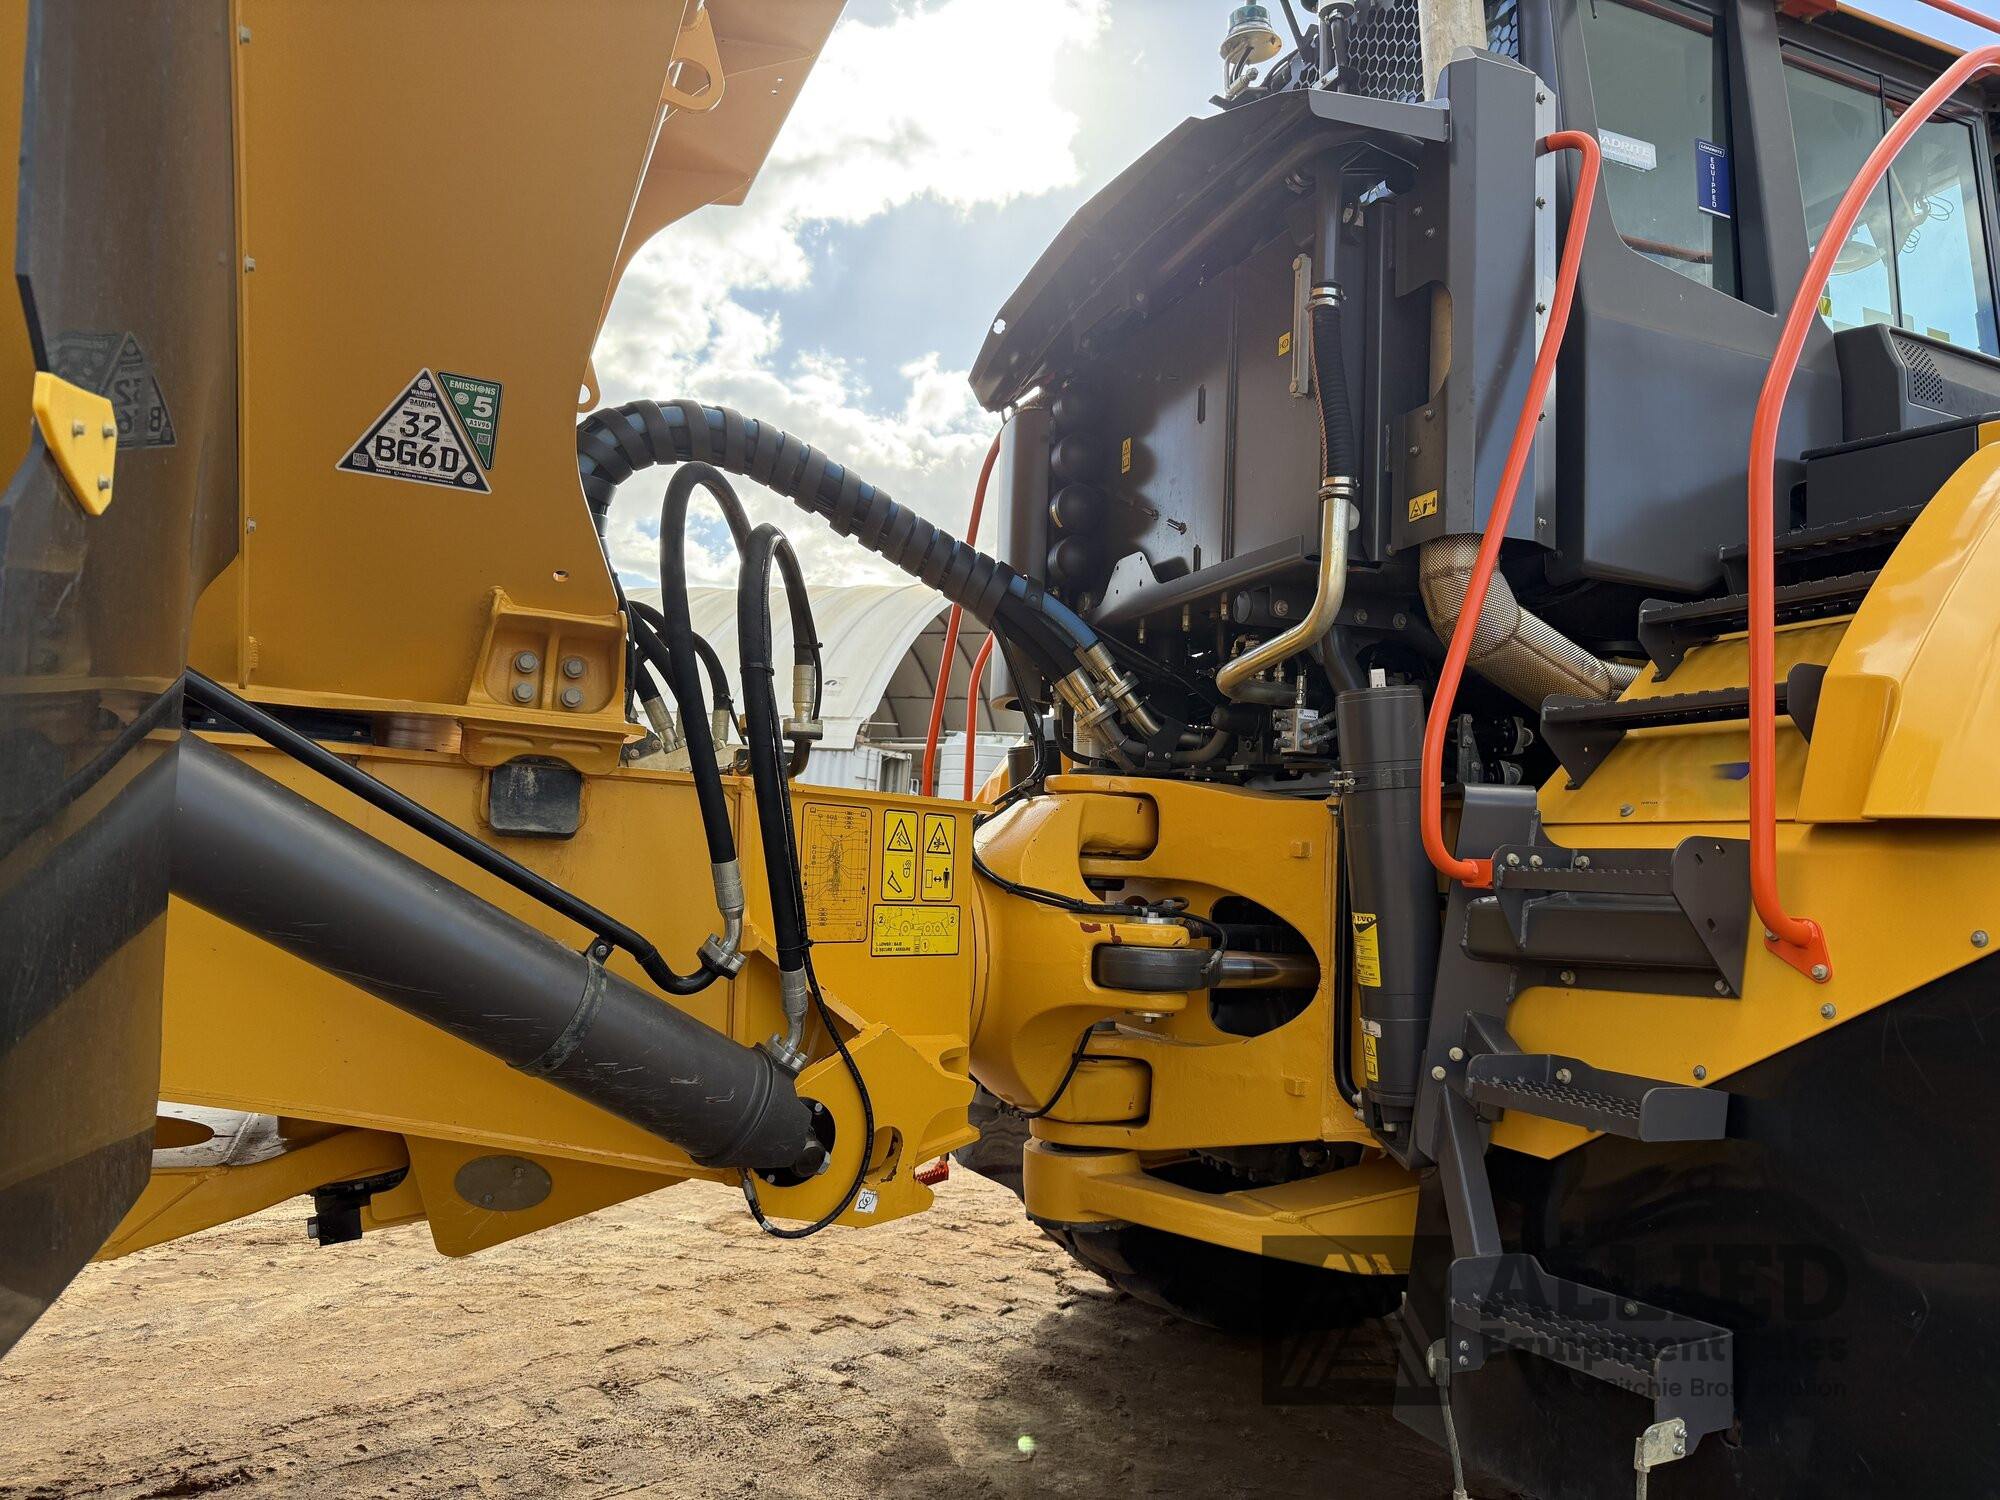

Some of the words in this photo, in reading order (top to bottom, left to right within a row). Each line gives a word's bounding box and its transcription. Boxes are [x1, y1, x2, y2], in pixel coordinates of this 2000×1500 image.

[1599, 134, 1651, 155] ADRITE
[1709, 156, 1717, 208] EQUIPPED
[472, 395, 493, 418] 5
[399, 410, 442, 443] 32
[469, 419, 490, 429] A1V96
[374, 434, 460, 473] BG6D
[878, 916, 884, 924] 2
[950, 916, 955, 924] 2
[923, 941, 927, 949] 1
